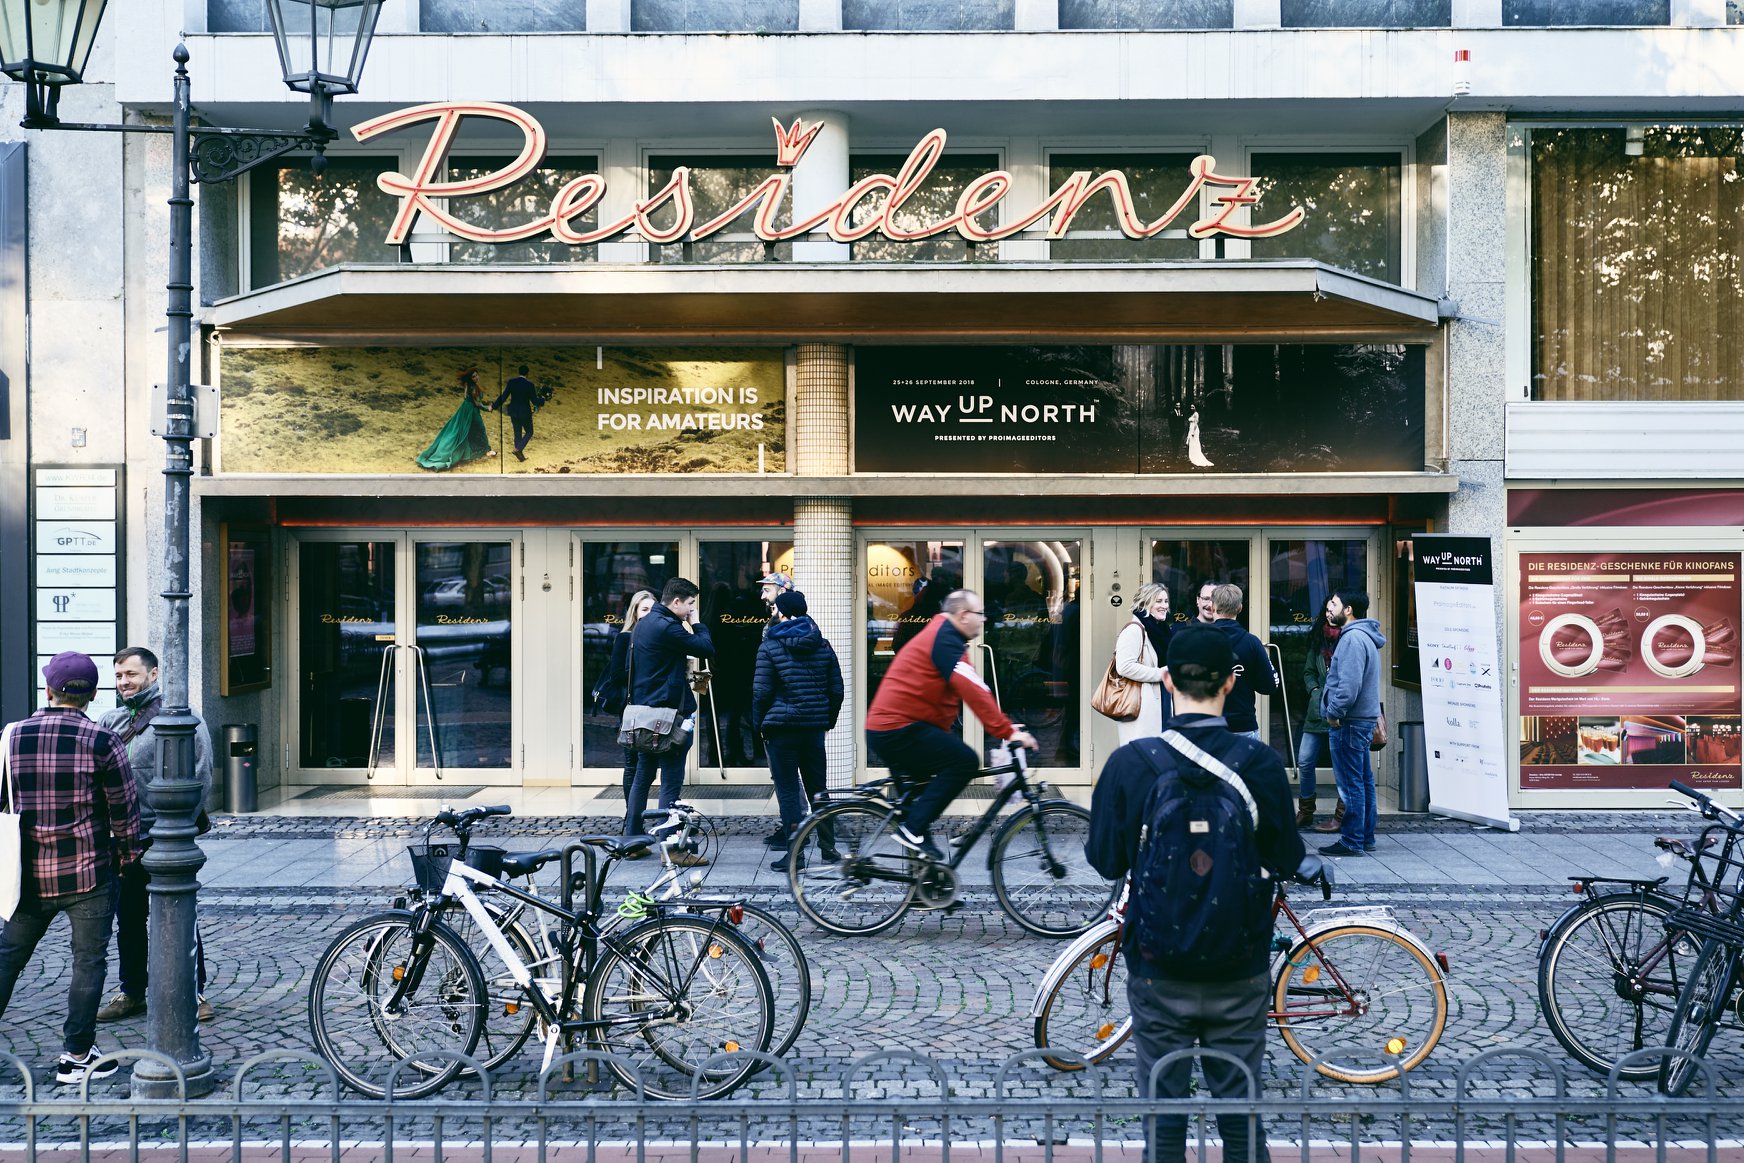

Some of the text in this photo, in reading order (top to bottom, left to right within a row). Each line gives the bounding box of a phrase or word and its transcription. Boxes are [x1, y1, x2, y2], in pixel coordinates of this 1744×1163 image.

[350, 101, 1305, 245] Residenz
[598, 387, 759, 405] INSPIRATION IS
[891, 404, 952, 423] WAY
[959, 395, 994, 414] UP
[1001, 404, 1095, 423] NORTH
[598, 413, 764, 431] FOR AMATEURS
[1422, 552, 1483, 567] WAY UP NORTH
[1528, 560, 1735, 572] DIE RESIDENZ-GESCHENKE FÜR KINOFANS
[320, 613, 376, 624] Residenz
[436, 614, 491, 624] Residenz
[719, 613, 770, 624] Residen
[887, 612, 933, 624] Residen
[1555, 641, 1588, 649] Residenz
[1657, 641, 1690, 649] Residenz
[1690, 770, 1736, 780] Residenz
